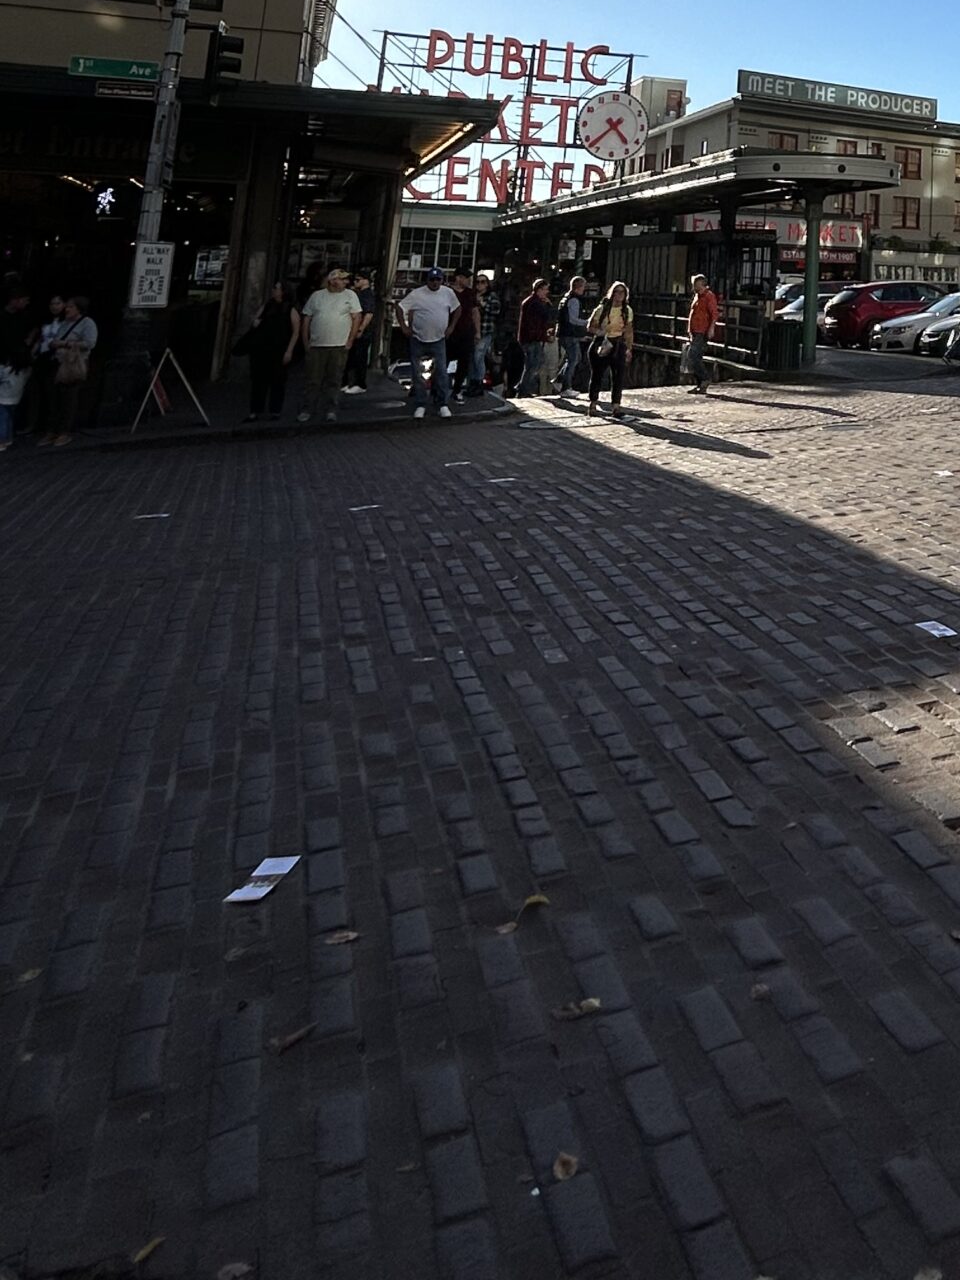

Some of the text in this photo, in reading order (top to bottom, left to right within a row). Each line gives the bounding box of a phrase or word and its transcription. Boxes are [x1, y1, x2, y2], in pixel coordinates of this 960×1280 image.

[425, 29, 610, 86] PUBLIC
[129, 64, 152, 76] Ave
[748, 74, 932, 116] MEET THE PRODUCER
[142, 246, 170, 255] ALL WAY
[146, 257, 163, 265] WALK
